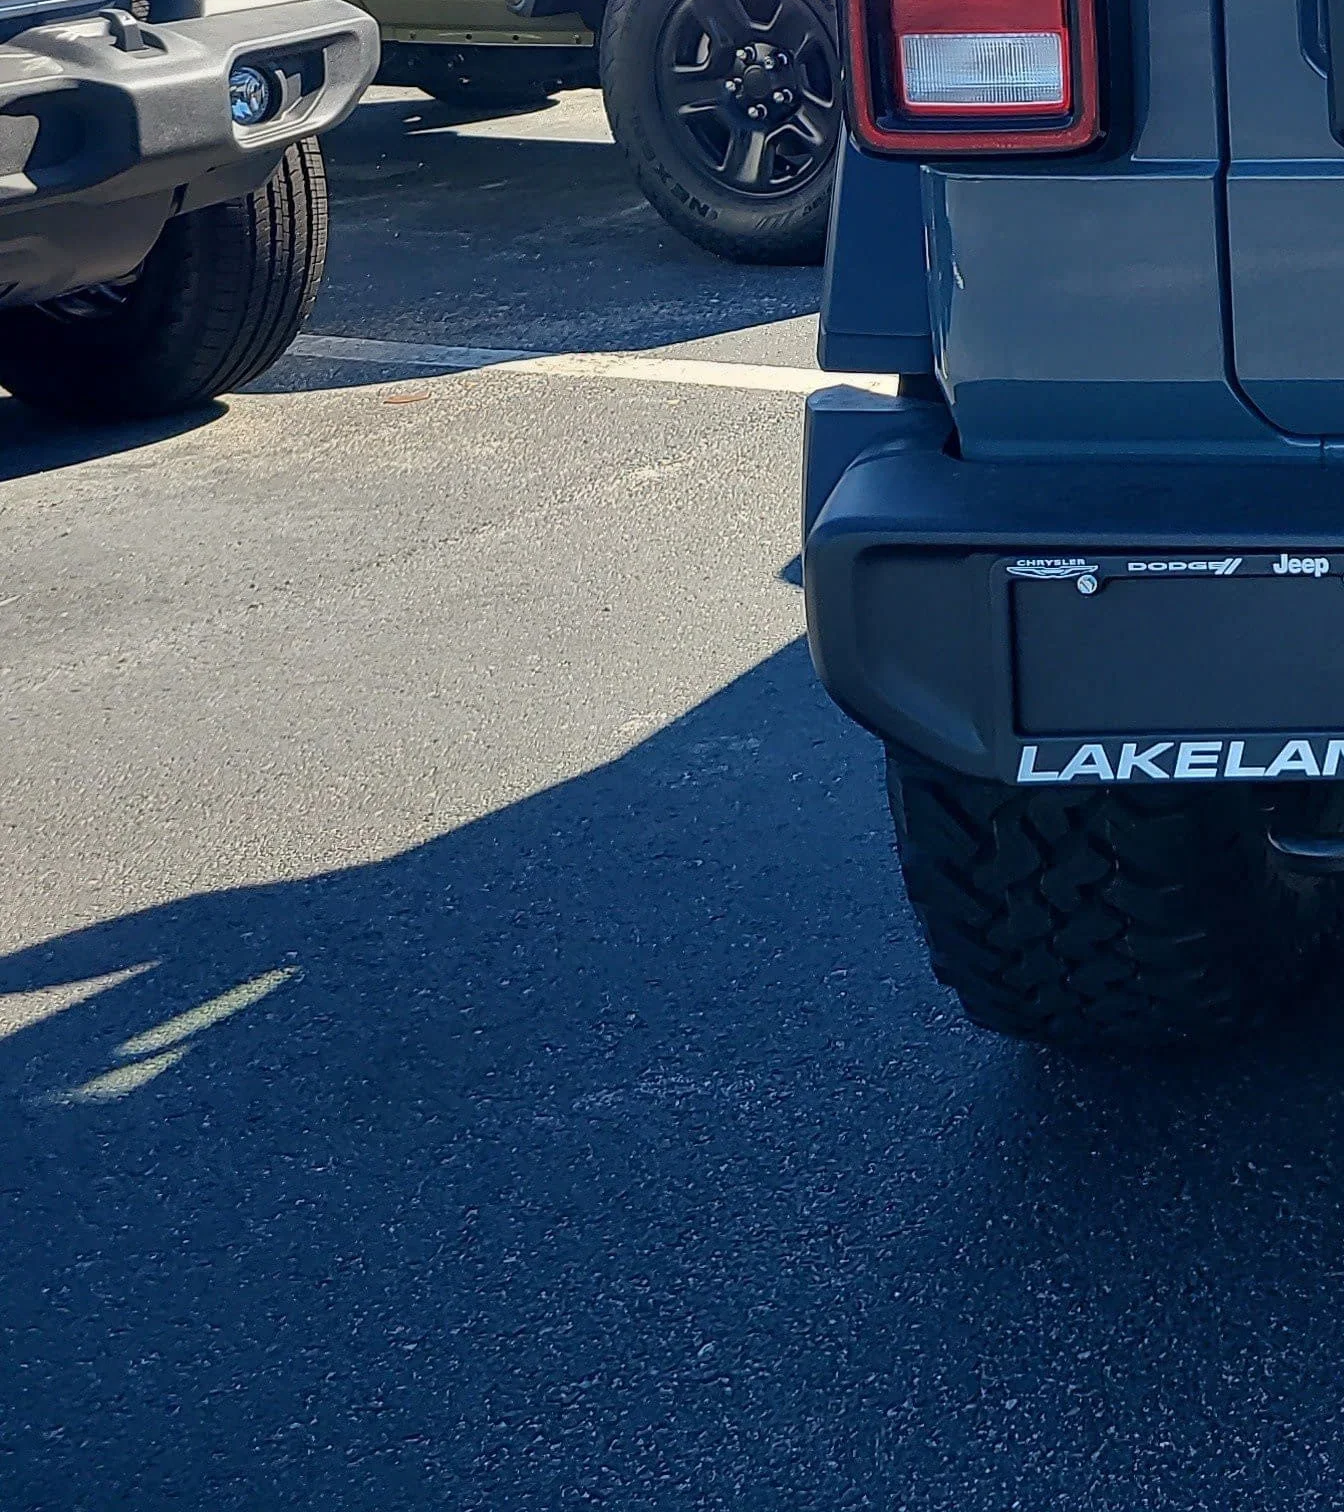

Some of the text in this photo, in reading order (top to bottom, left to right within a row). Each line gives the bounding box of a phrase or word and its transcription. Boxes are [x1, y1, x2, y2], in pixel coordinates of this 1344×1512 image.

[1016, 558, 1086, 567] CHRYSLER
[1127, 561, 1228, 571] DODGE
[1272, 553, 1330, 576] Jeep
